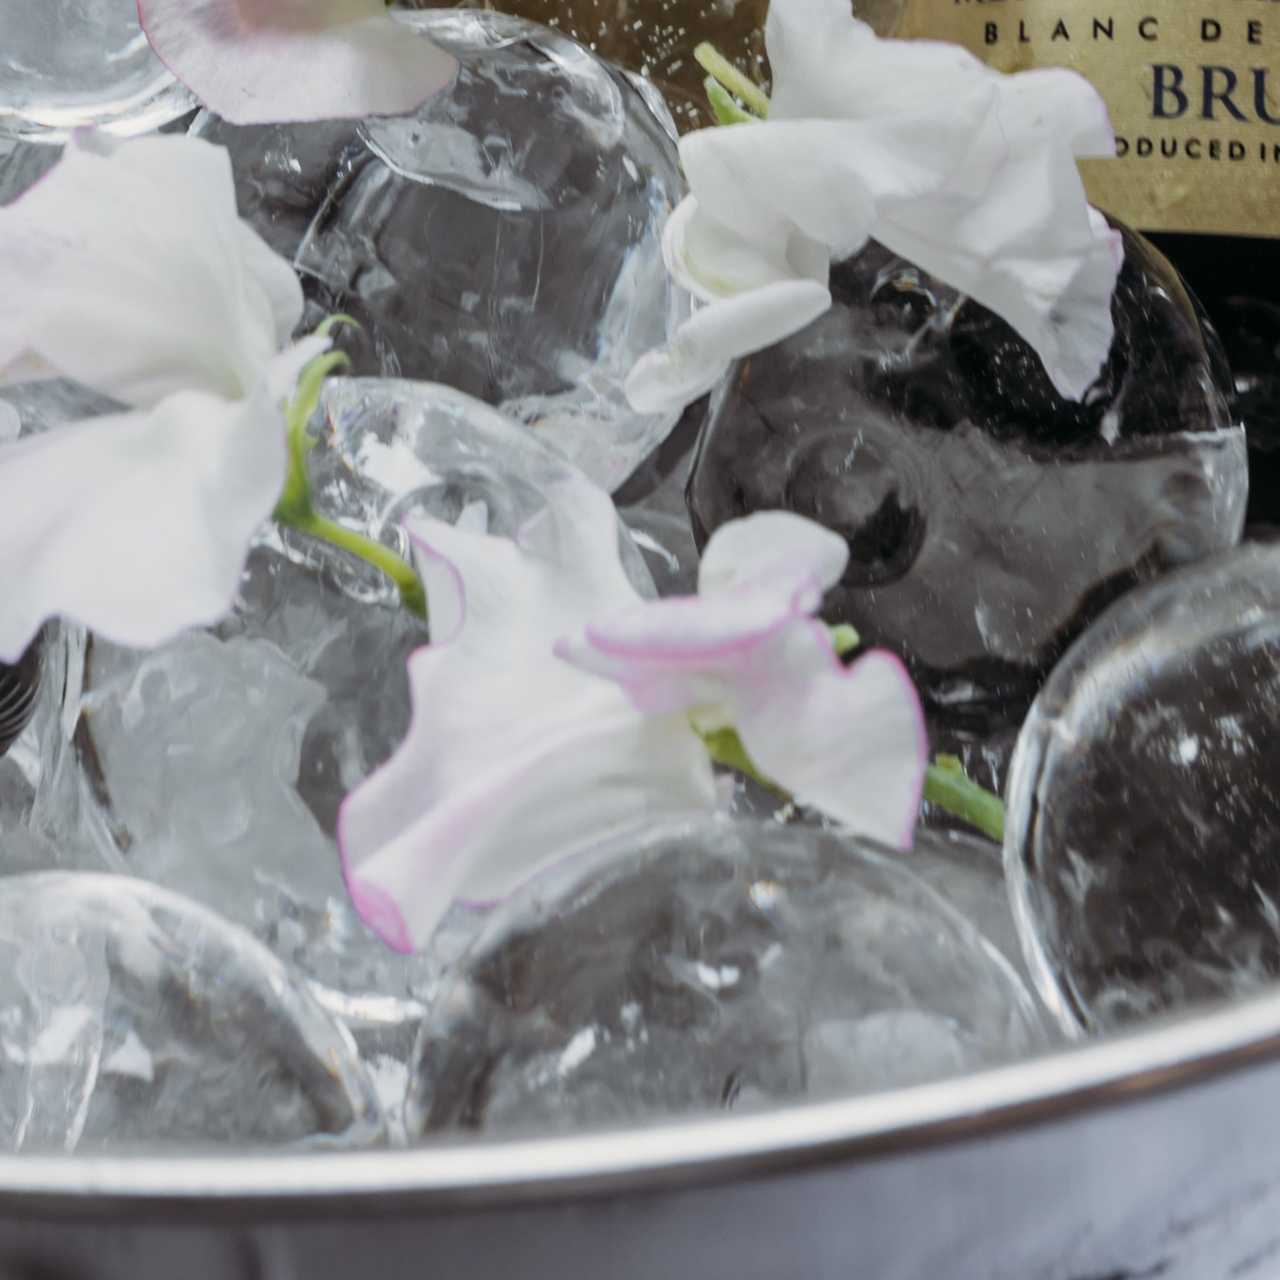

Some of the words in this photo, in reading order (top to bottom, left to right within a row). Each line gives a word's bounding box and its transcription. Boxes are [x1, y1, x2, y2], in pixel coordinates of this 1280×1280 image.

[984, 16, 1158, 46] BLANC
[1200, 18, 1263, 45] DE
[1114, 136, 1247, 162] ODUCED
